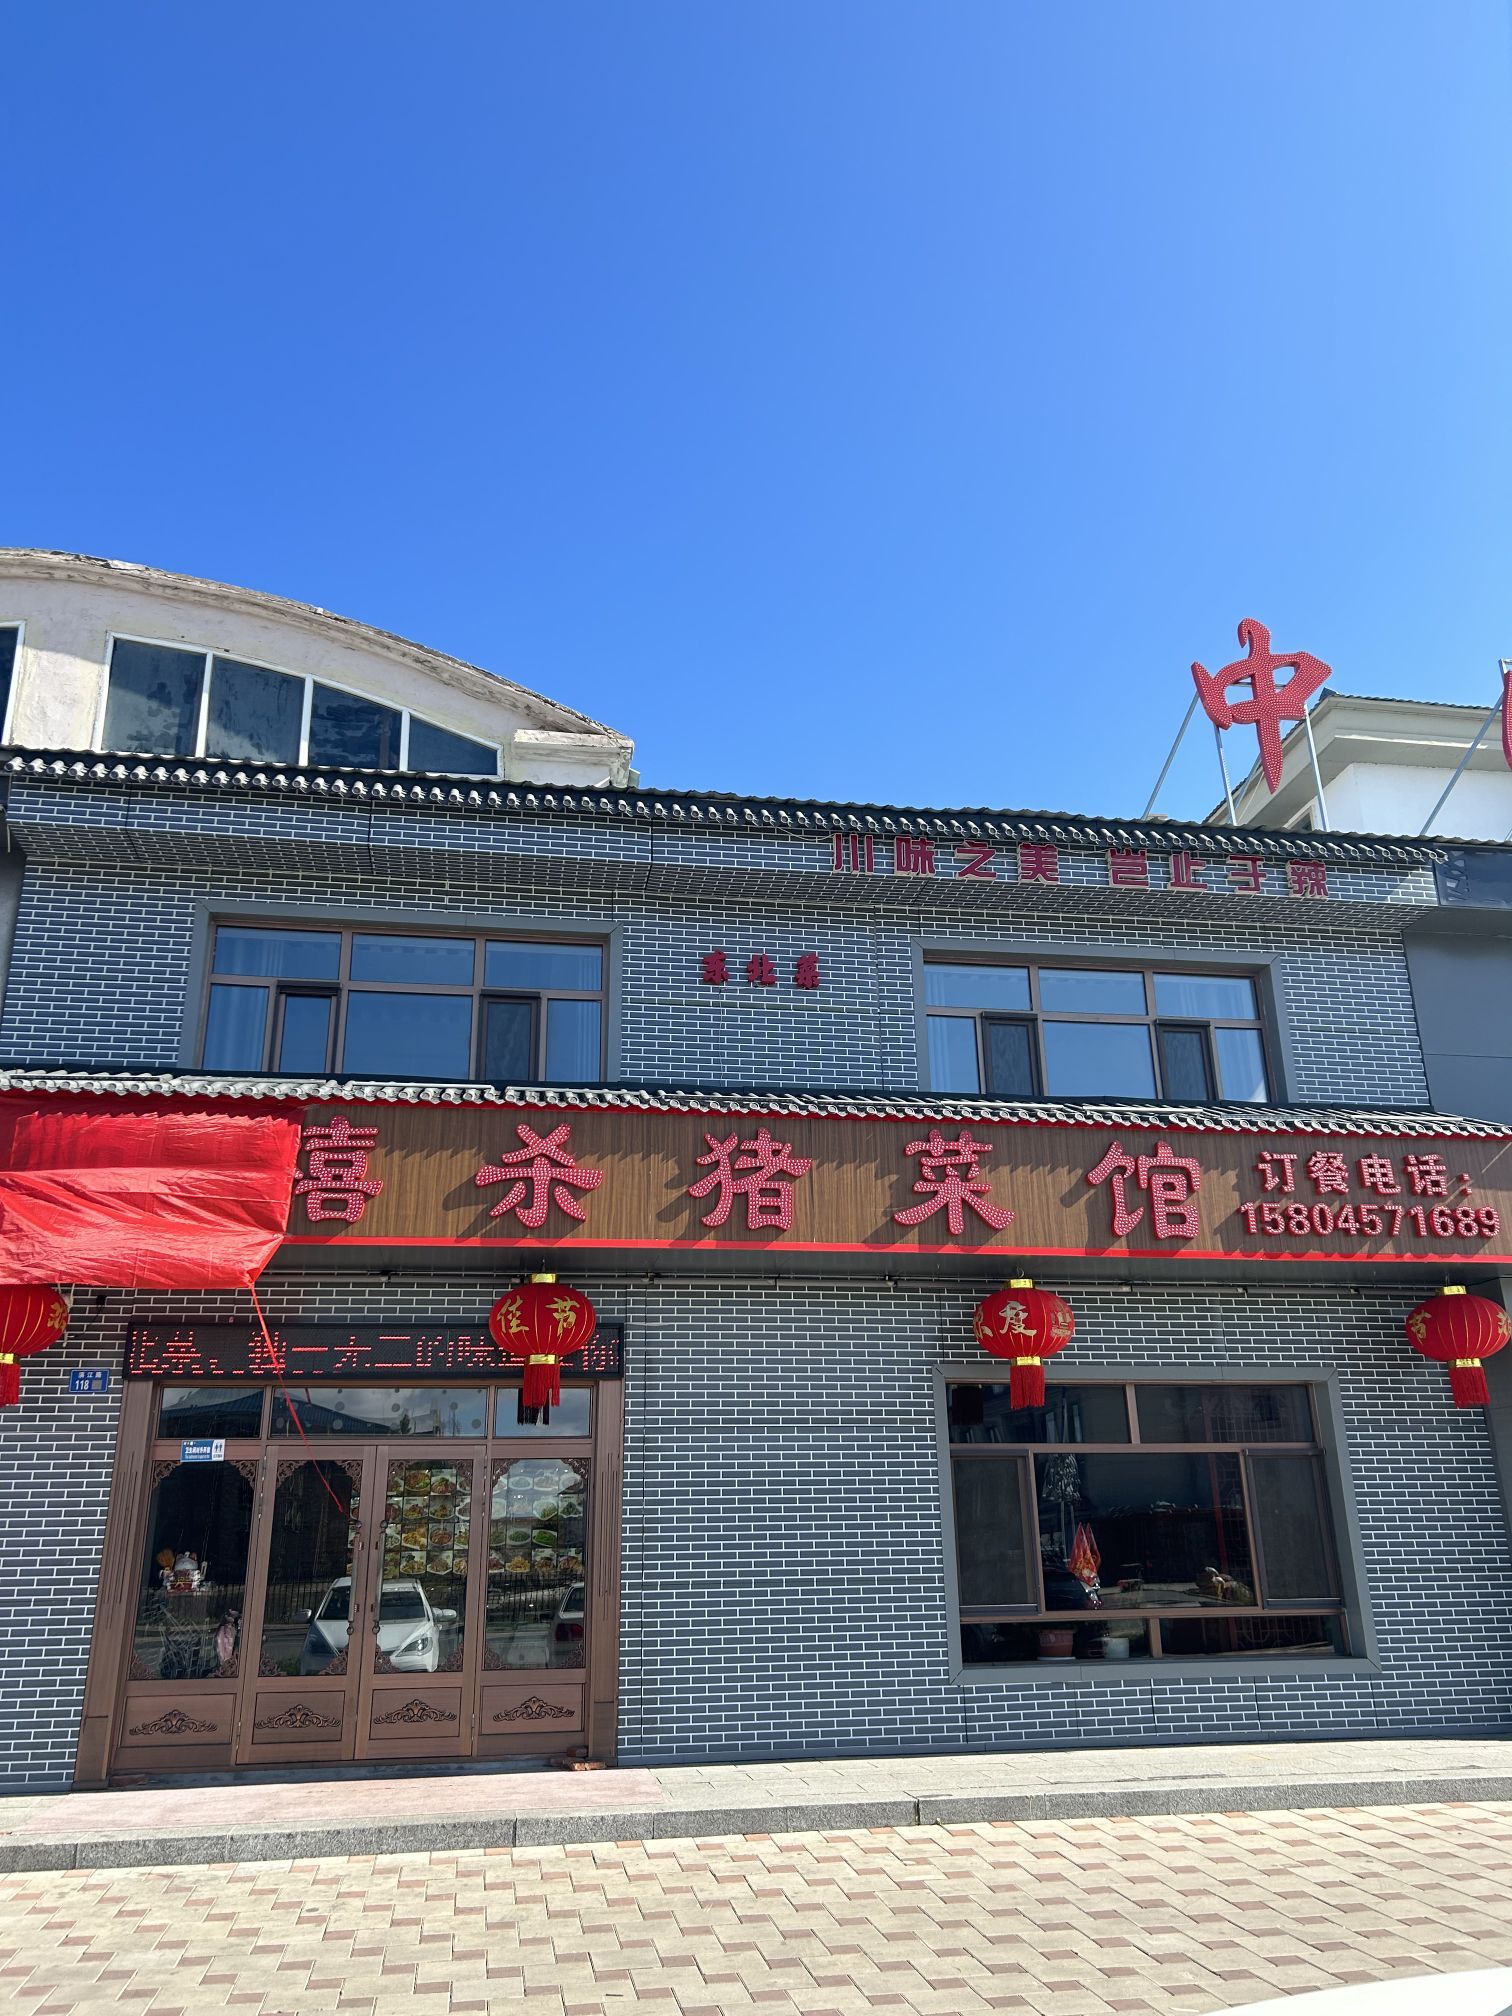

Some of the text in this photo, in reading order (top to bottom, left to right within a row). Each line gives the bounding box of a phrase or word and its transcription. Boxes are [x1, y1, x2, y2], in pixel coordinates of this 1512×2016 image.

[1190, 617, 1333, 795] 中
[833, 833, 1328, 899] 川味之美 岂止于辣
[1257, 1150, 1474, 1197] 订餐电话：
[1239, 1200, 1501, 1239] 15804571689
[75, 1379, 90, 1391] 118
